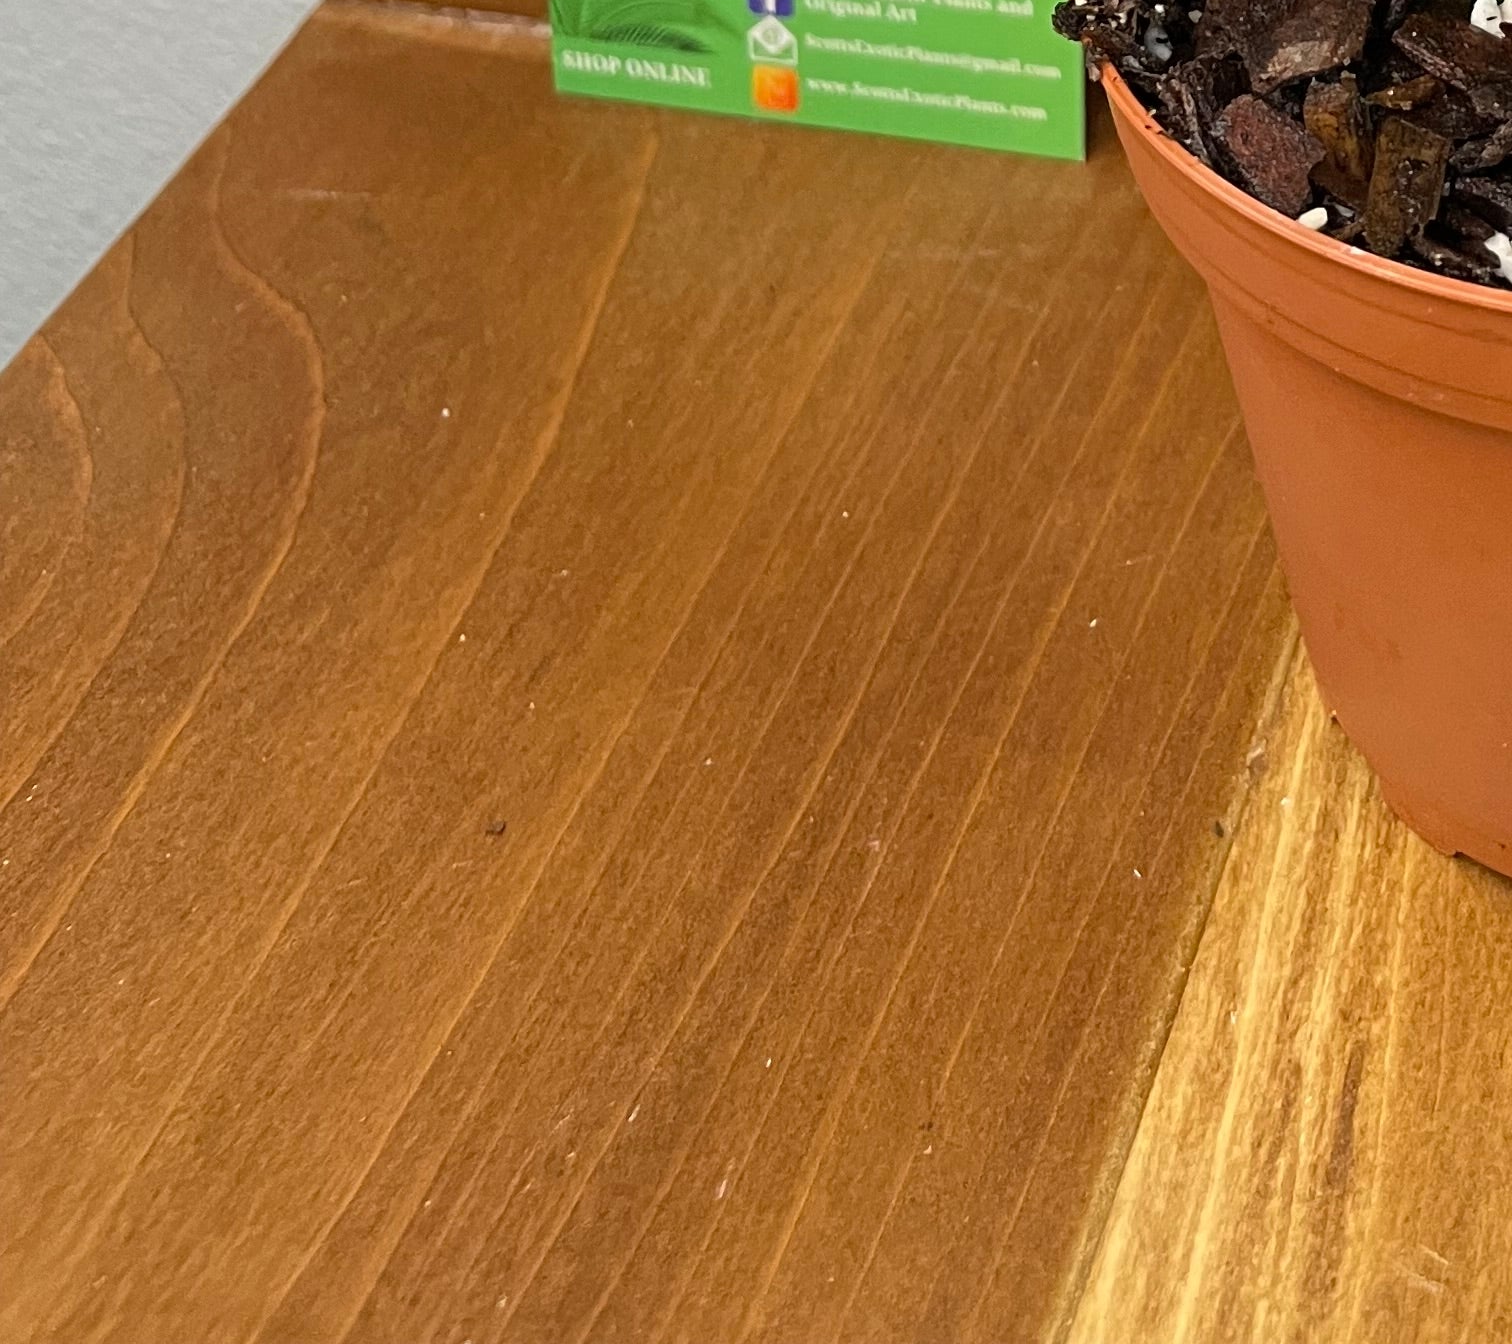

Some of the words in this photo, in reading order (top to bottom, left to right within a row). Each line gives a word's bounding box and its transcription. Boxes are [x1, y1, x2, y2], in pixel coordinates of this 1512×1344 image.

[886, 2, 917, 23] Art
[561, 49, 622, 76] SHOP
[625, 57, 712, 88] ONLINE
